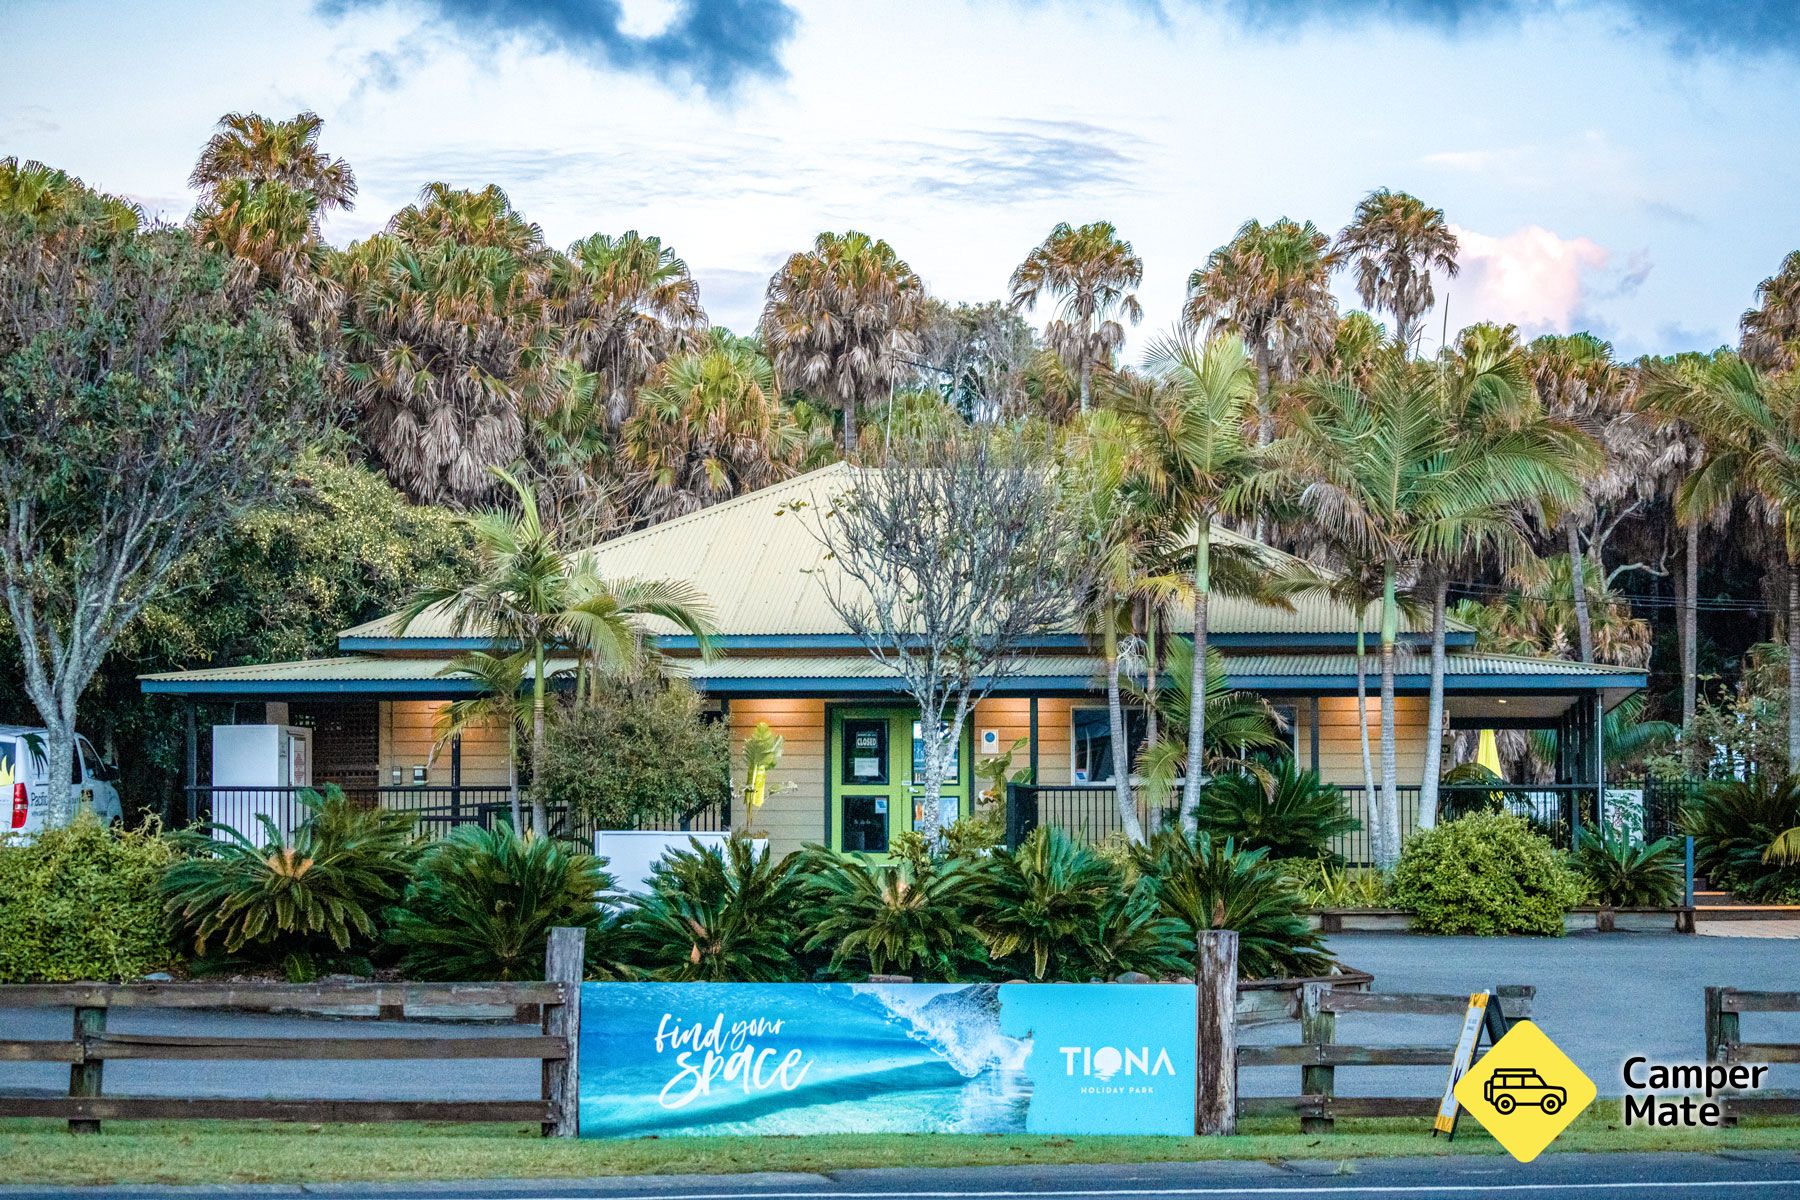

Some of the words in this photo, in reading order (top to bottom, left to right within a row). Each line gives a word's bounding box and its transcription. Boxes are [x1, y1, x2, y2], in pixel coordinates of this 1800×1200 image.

[857, 738, 877, 746] CLOSED
[654, 1012, 730, 1054] find
[730, 1017, 785, 1050] your
[658, 1044, 814, 1109] space
[1059, 1046, 1176, 1082] TIONA
